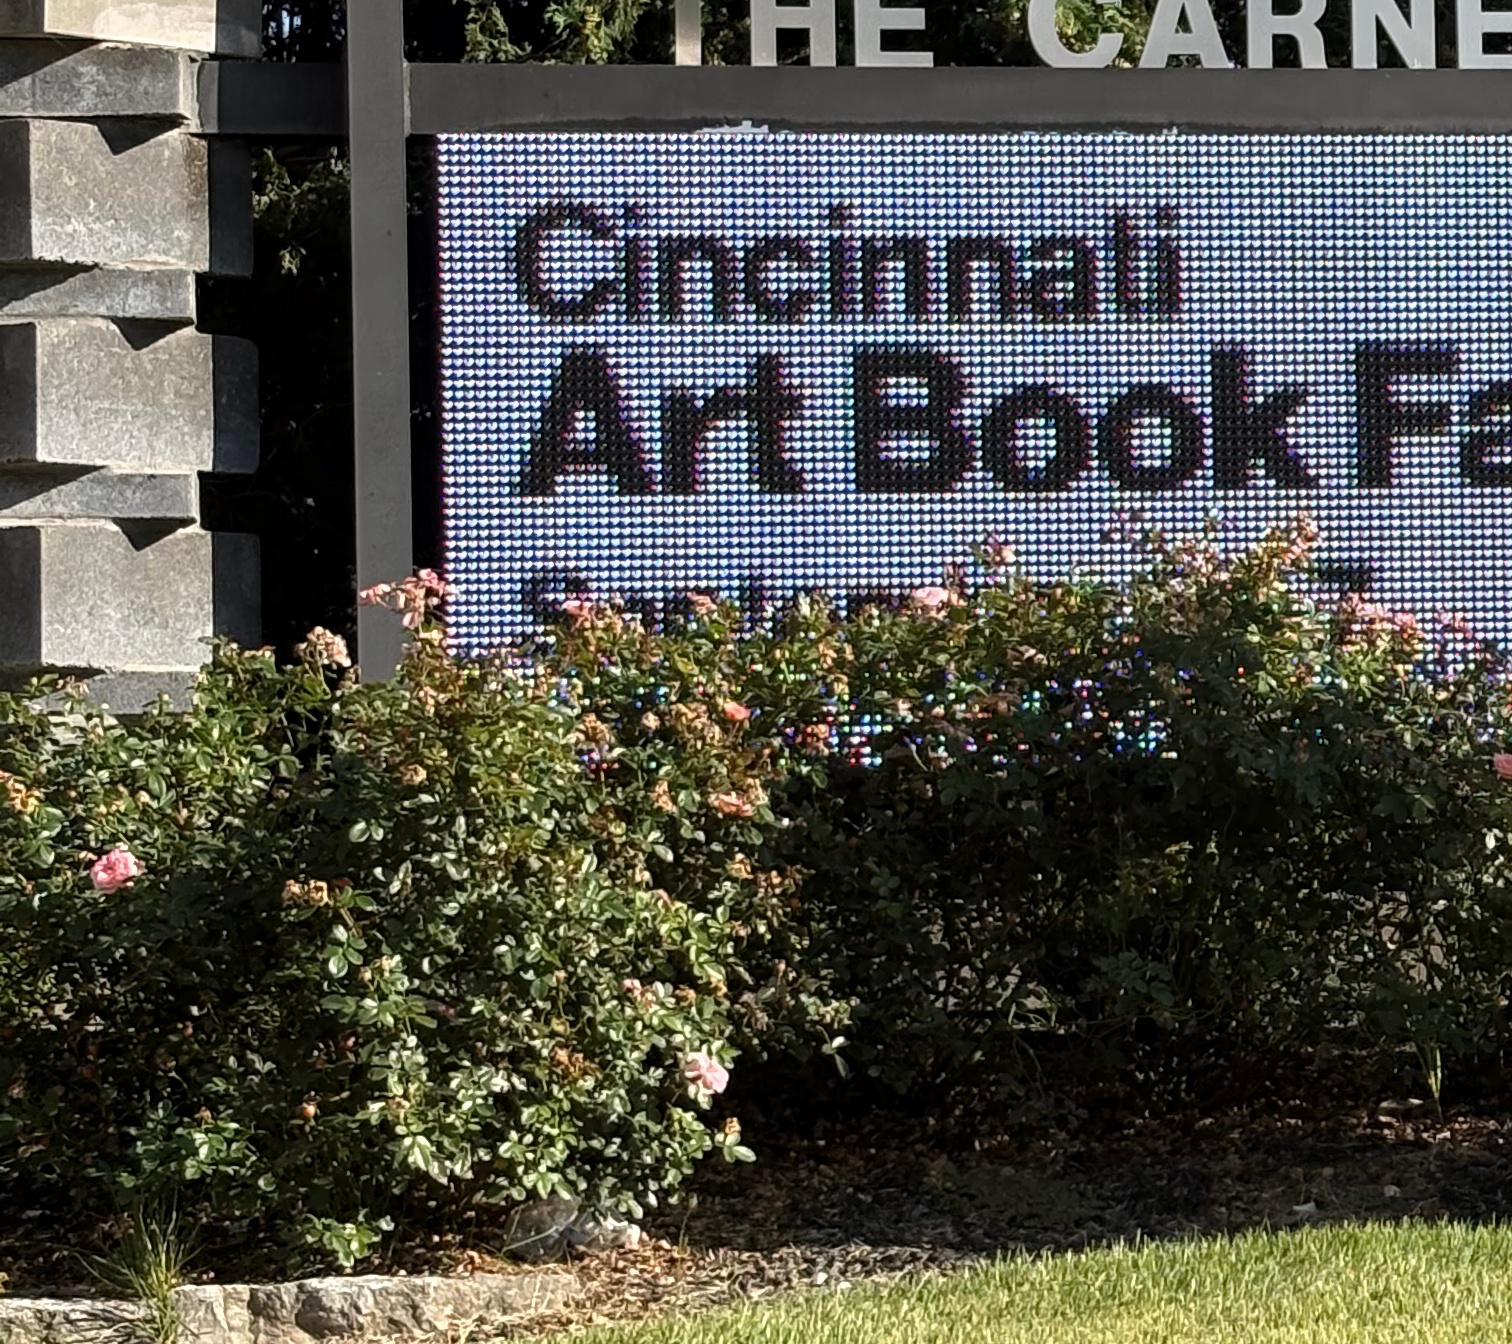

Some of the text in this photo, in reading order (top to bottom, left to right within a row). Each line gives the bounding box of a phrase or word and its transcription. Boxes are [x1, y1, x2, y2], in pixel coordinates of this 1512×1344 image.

[513, 200, 1182, 324] Cincinnati
[513, 343, 806, 494] Art
[851, 341, 1317, 492] Book
